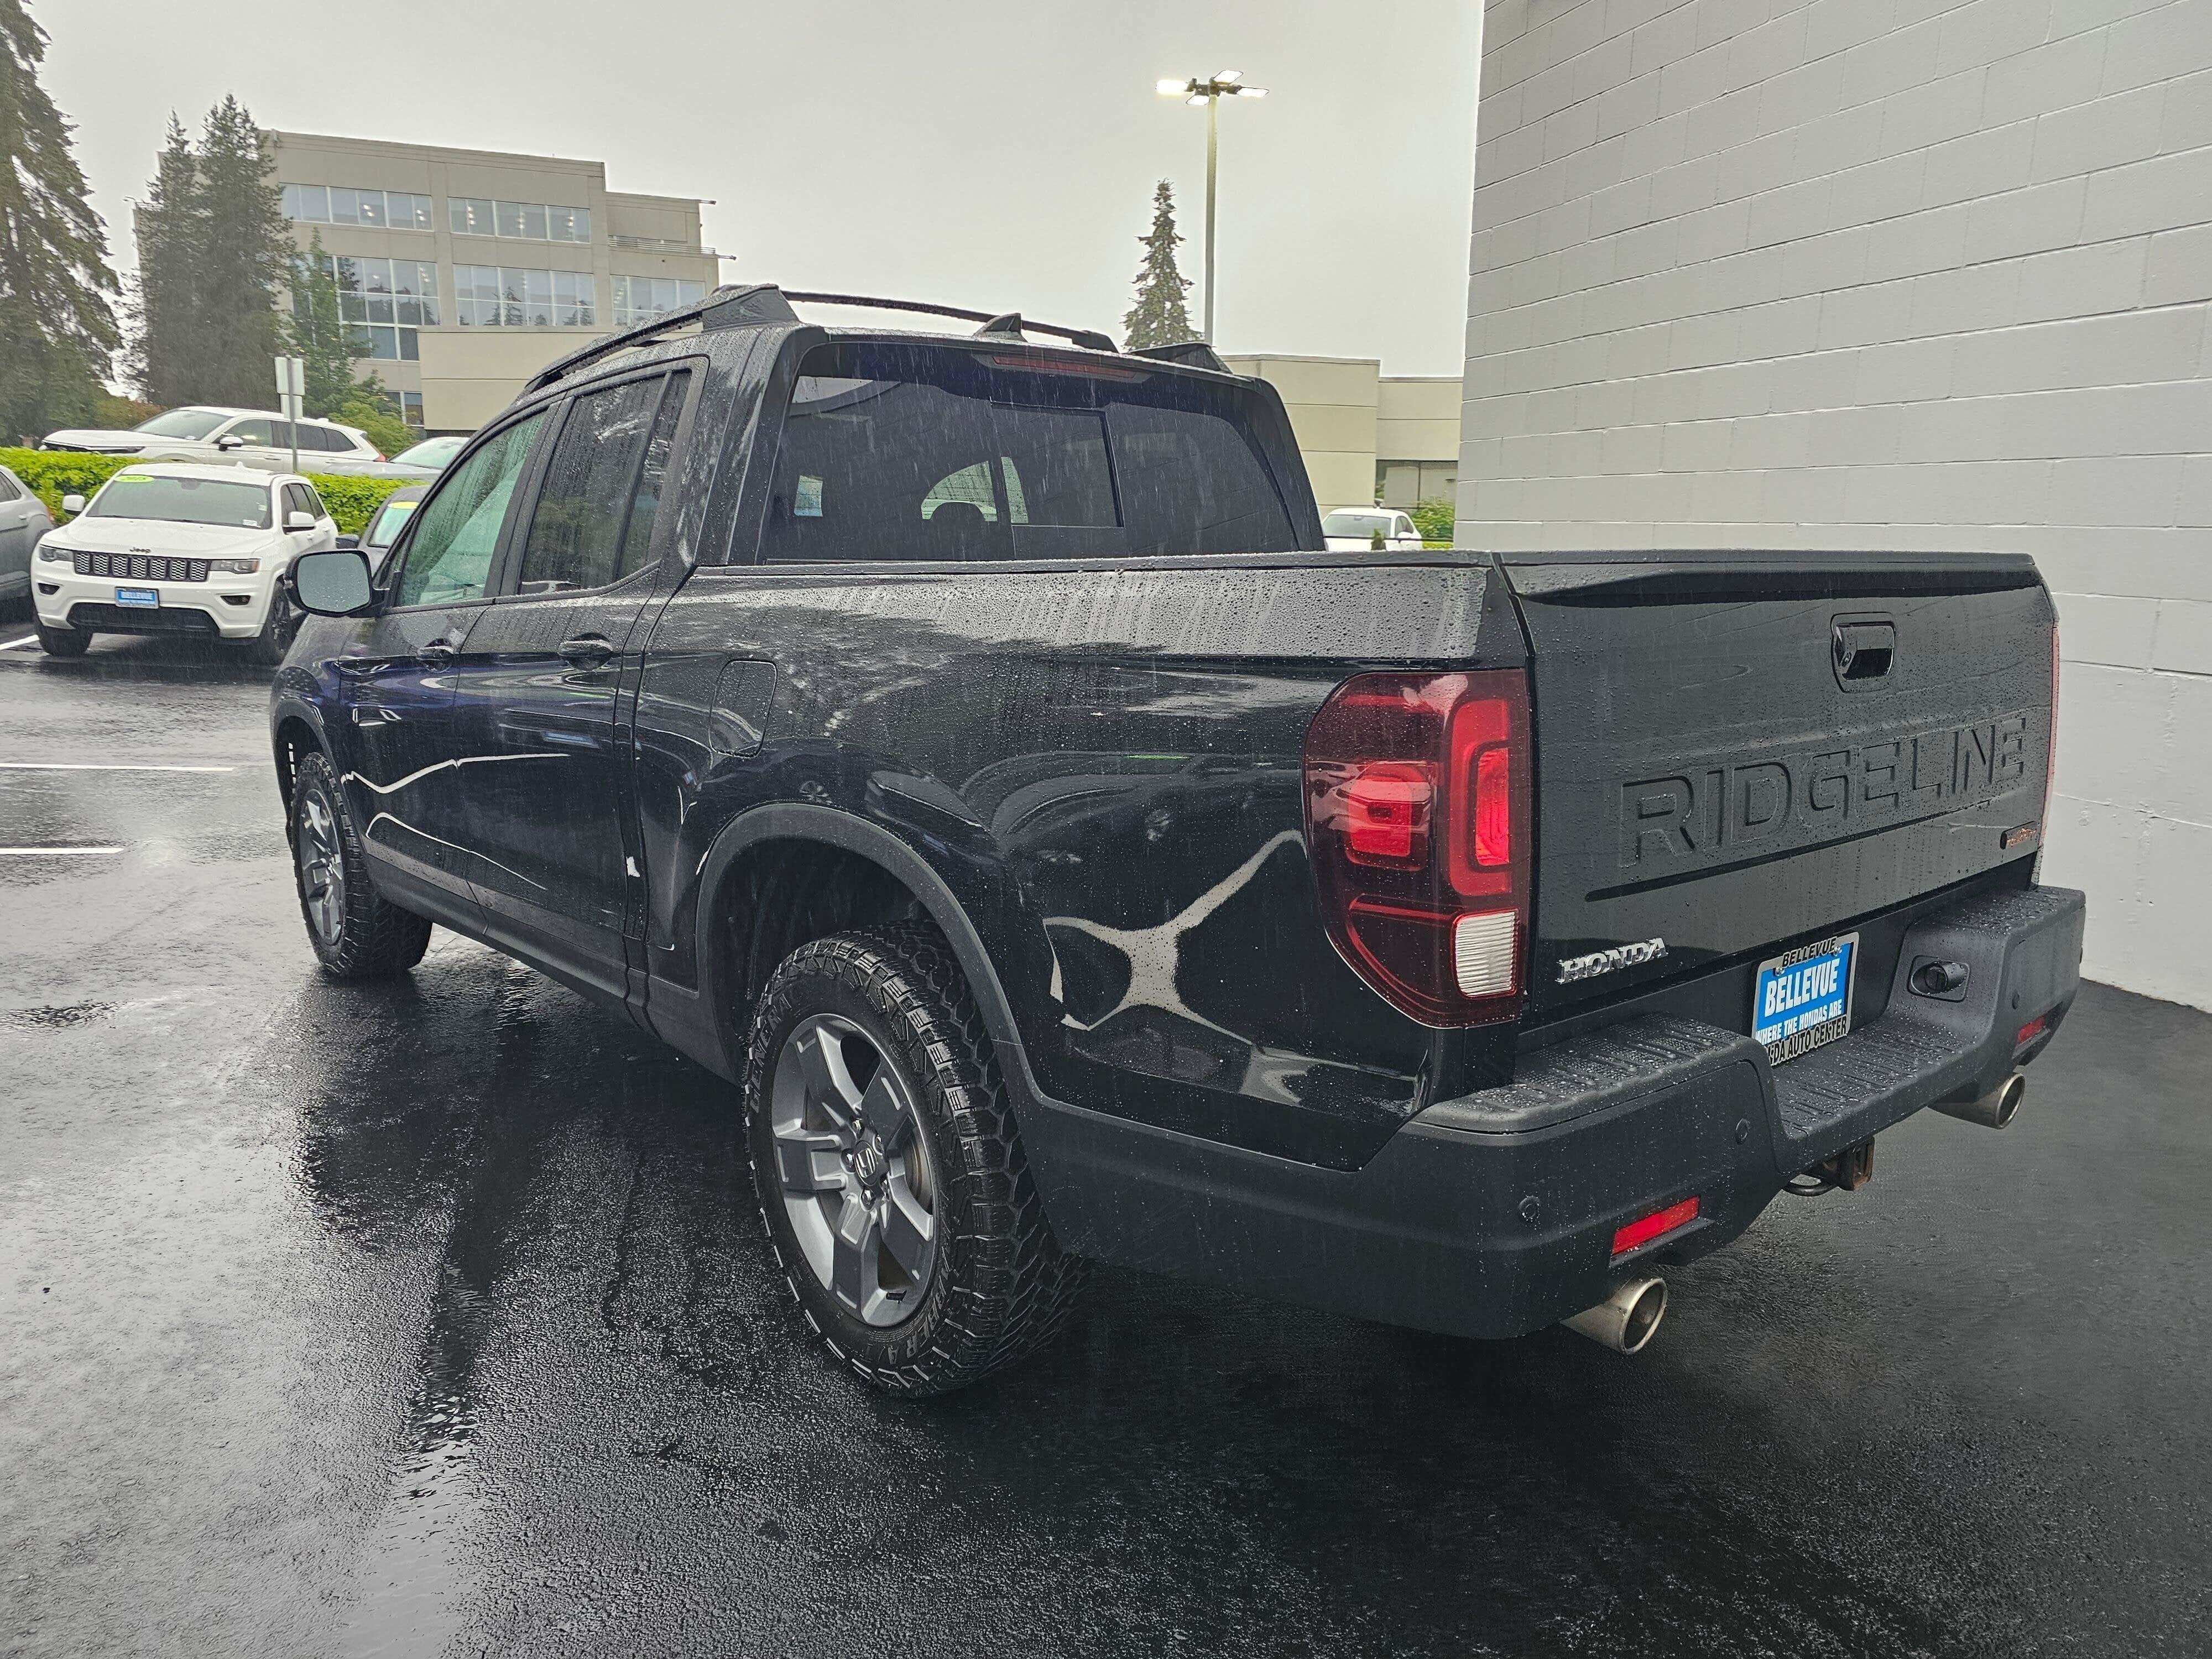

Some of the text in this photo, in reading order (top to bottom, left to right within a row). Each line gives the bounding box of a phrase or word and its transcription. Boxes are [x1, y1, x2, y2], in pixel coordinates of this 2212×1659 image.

[1618, 717, 2027, 868] RIDGELINE
[1555, 937, 1669, 984] HONDA
[1782, 937, 1837, 967] BELLEVUE
[1764, 958, 1840, 1017] BELLEVUE
[1755, 999, 1843, 1046] WHERE THE HONDAS ARE
[1787, 1029, 1811, 1057] AUTO
[1814, 1016, 1847, 1046] CENTER
